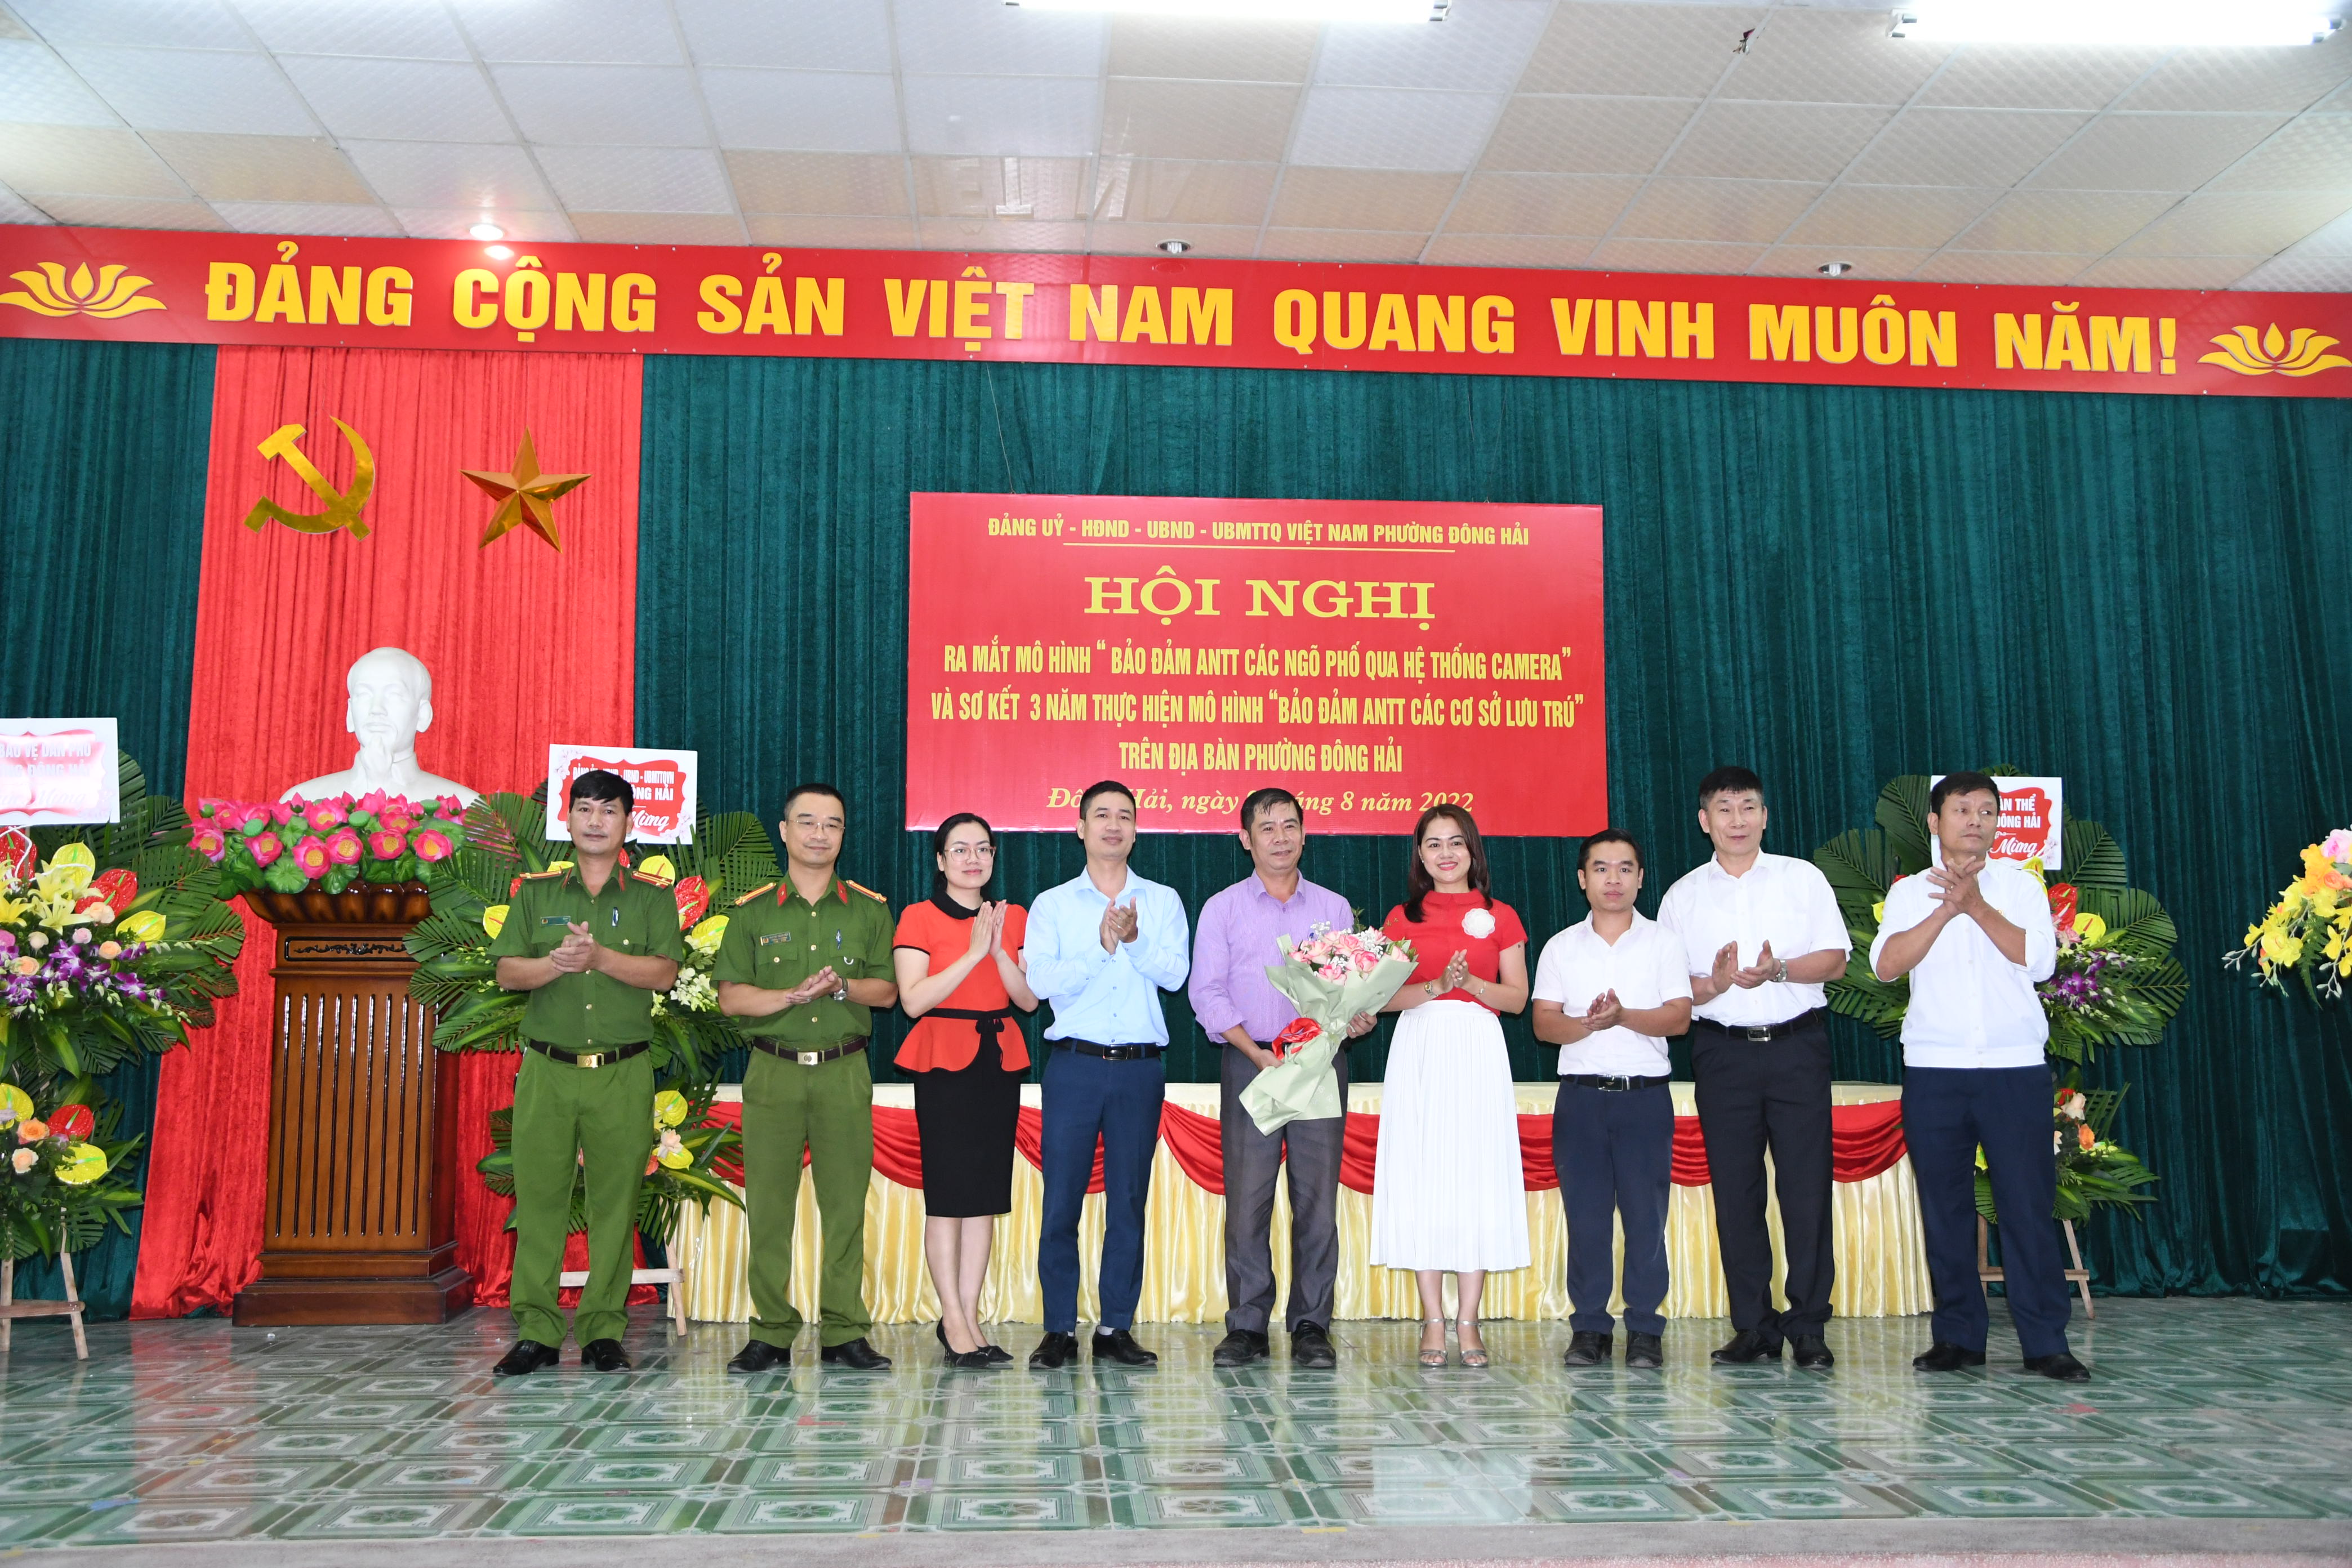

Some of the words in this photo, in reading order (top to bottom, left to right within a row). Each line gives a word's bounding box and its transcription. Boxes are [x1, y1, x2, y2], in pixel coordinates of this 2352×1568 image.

[204, 240, 413, 326] ĐẢNG
[453, 255, 657, 342] CỘNG
[697, 252, 845, 336] SẢN
[883, 266, 1035, 353] VIỆT
[1069, 283, 1233, 346] NAM
[1273, 289, 1515, 354] QUANG
[1551, 298, 1715, 360] VINH
[1749, 294, 1958, 368] MUÔN
[1994, 301, 2177, 375] NĂM!
[987, 512, 1036, 537] ĐẢNG
[1041, 513, 1064, 537] UỶ
[1081, 519, 1130, 538] HĐND
[1147, 520, 1195, 539] UBND
[1212, 522, 1282, 543] UBMTTQ
[1286, 519, 1323, 545] VIỆT
[1328, 523, 1368, 542] NAM
[1373, 521, 1444, 544] PHƯỜNG
[1448, 523, 1495, 545] ĐÔNG
[1500, 522, 1529, 546] HẢI
[1084, 565, 1220, 626] HỘI
[1245, 580, 1435, 631] NGHỊ
[944, 645, 967, 672] RA
[972, 635, 1010, 672] MẮT
[1015, 640, 1043, 673] MÔ
[1049, 640, 1091, 674] HÌNH
[1097, 639, 1106, 650] “
[1111, 638, 1146, 675] BẢO
[1151, 638, 1191, 675] ĐẢM
[1196, 648, 1240, 676] ANTT
[1244, 643, 1279, 676] CÁC
[1284, 644, 1320, 677] NGÕ
[1325, 640, 1360, 678] PHỐ
[1365, 650, 1399, 681] QUA
[1404, 645, 1426, 684] HỆ
[1430, 642, 1486, 679] THỐNG
[1491, 647, 1571, 680] CAMERA”
[931, 687, 954, 720] VÀ
[959, 690, 983, 720] SƠ
[988, 684, 1020, 720] KẾT
[1030, 693, 1041, 721] 3
[1046, 688, 1087, 721] NĂM
[1092, 692, 1137, 728] THỰC
[1142, 689, 1183, 728] HIỆN
[1188, 689, 1216, 723] MÔ
[1222, 690, 1263, 723] HÌNH
[1269, 687, 1313, 724] “BẢO
[1317, 688, 1357, 724] ĐẢM
[1362, 697, 1406, 725] ANTT
[1410, 693, 1445, 726] CÁC
[1450, 696, 1473, 726] CƠ
[1478, 691, 1502, 727] SỞ
[1506, 697, 1538, 727] LƯU
[1542, 693, 1584, 728] TRÚ”
[1119, 736, 1164, 770] TRÊN
[1168, 742, 1199, 776] ĐỊA
[1204, 737, 1240, 770] BÀN
[1245, 737, 1316, 772] PHƯỜNG
[1320, 738, 1368, 772] ĐÔNG
[1374, 736, 1402, 772] HẢI
[654, 783, 674, 801] HẢI
[1046, 787, 1083, 808] Đô
[1181, 790, 1239, 815] ngày
[1340, 791, 1355, 811] 8
[1361, 792, 1412, 811] năm
[1419, 792, 1474, 812] 2022
[2015, 793, 2037, 812] THỂ
[2024, 812, 2041, 828] HẢI
[1990, 837, 2038, 858] Mừng
